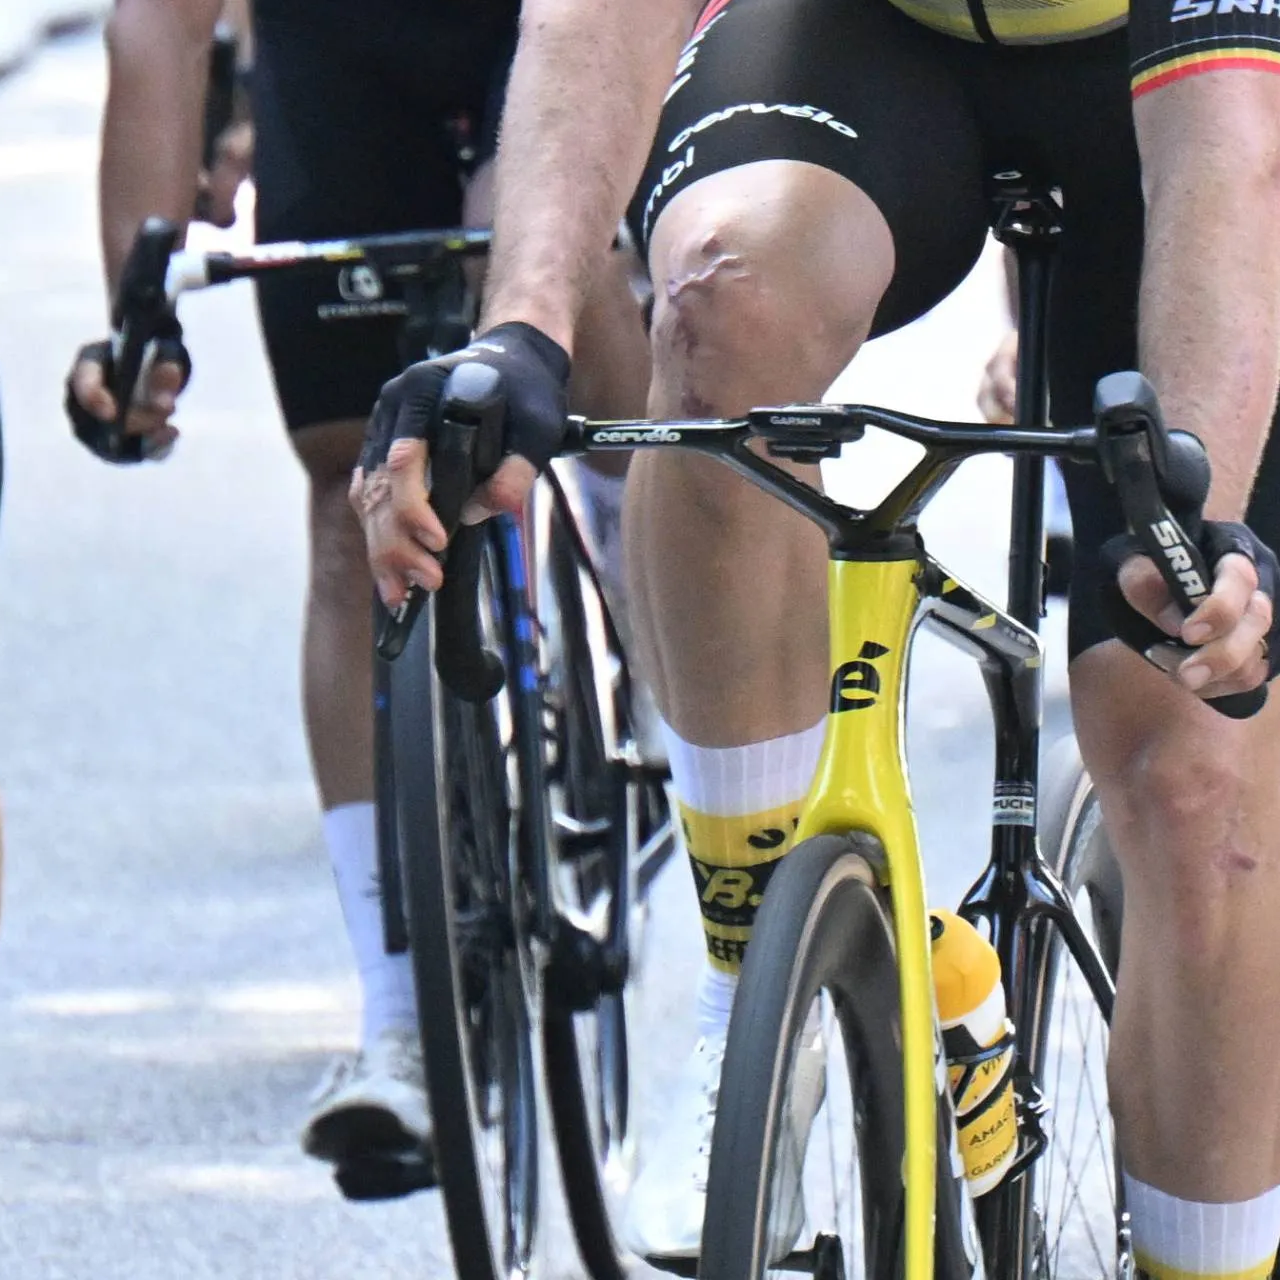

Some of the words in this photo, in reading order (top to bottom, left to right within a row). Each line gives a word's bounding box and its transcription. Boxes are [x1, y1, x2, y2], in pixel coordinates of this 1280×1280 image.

[668, 102, 858, 153] cervélo
[770, 415, 822, 426] GARMIN
[592, 427, 682, 443] cervélo
